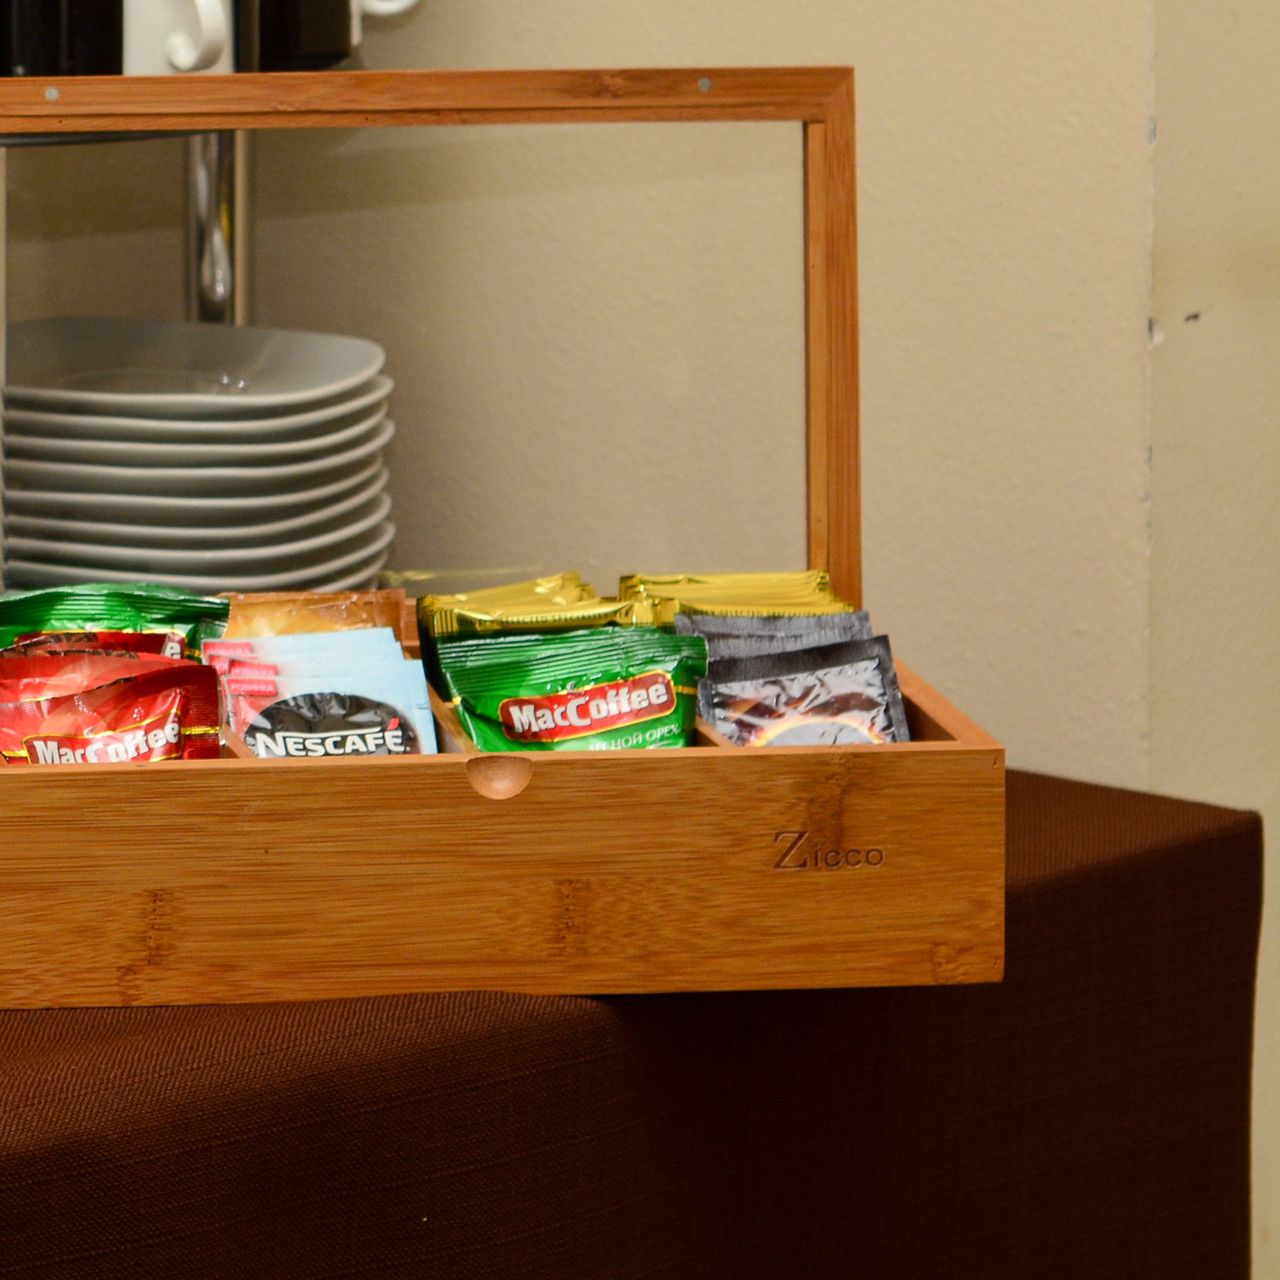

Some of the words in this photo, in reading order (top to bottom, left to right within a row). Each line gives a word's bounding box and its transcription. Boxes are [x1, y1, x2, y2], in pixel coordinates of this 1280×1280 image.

[509, 683, 669, 734] MacCoffee
[32, 722, 180, 764] MacCoffee
[255, 717, 404, 758] NESCAFÉ
[773, 830, 885, 870] Zicco
